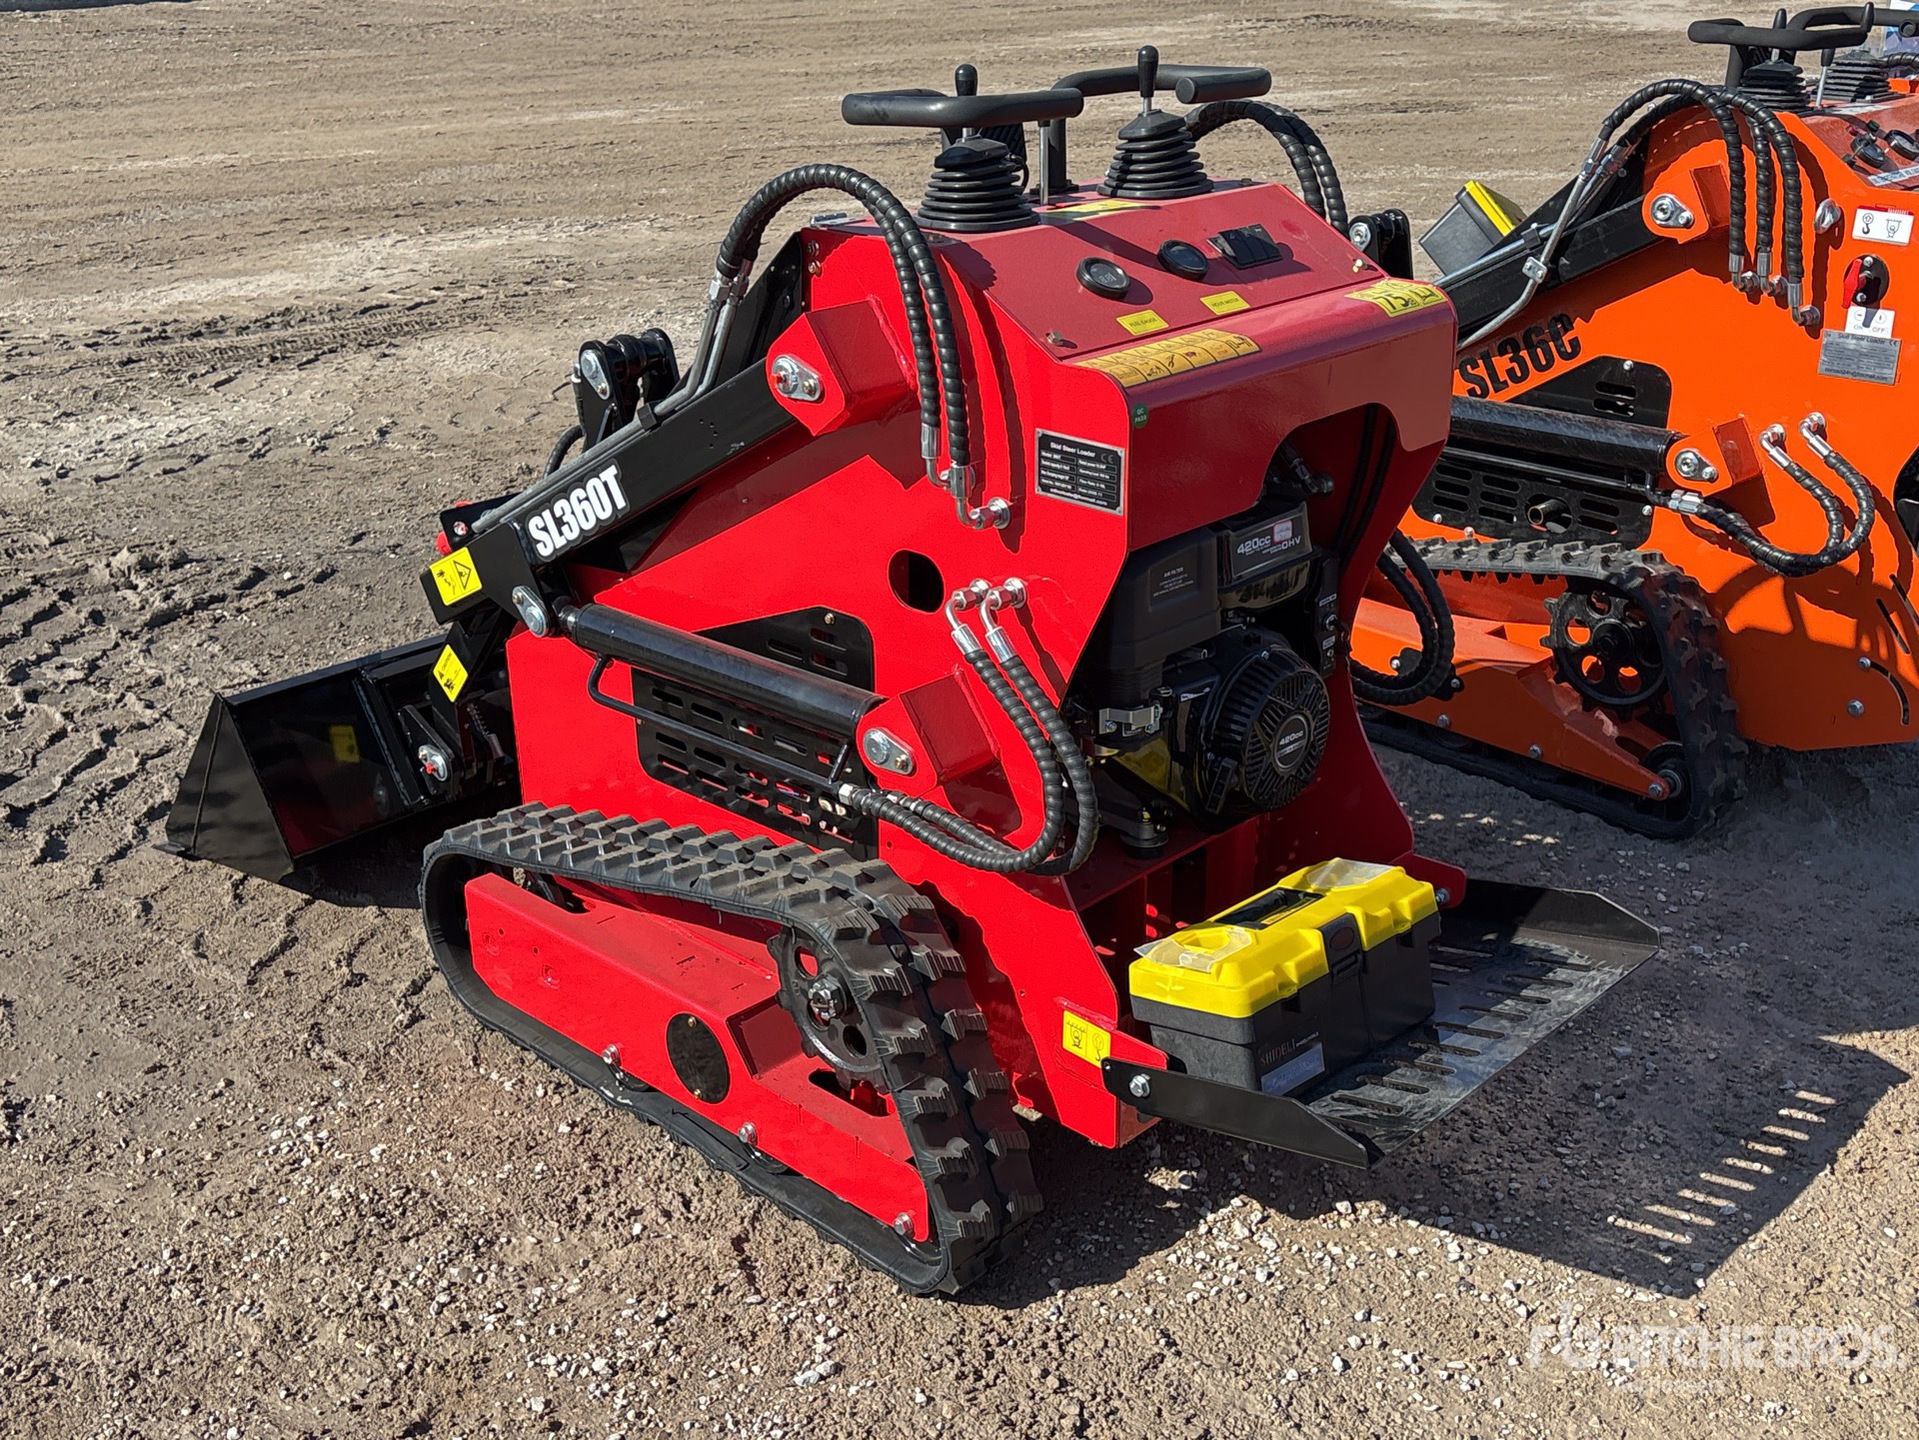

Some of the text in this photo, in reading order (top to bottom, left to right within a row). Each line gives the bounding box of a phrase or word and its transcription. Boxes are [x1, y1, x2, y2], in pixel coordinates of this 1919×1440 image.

[1077, 447, 1096, 458] Loader
[528, 465, 626, 557] SL360T
[1237, 535, 1271, 554] 420cc
[1281, 535, 1301, 550] OHV
[1279, 730, 1304, 746] 420cc
